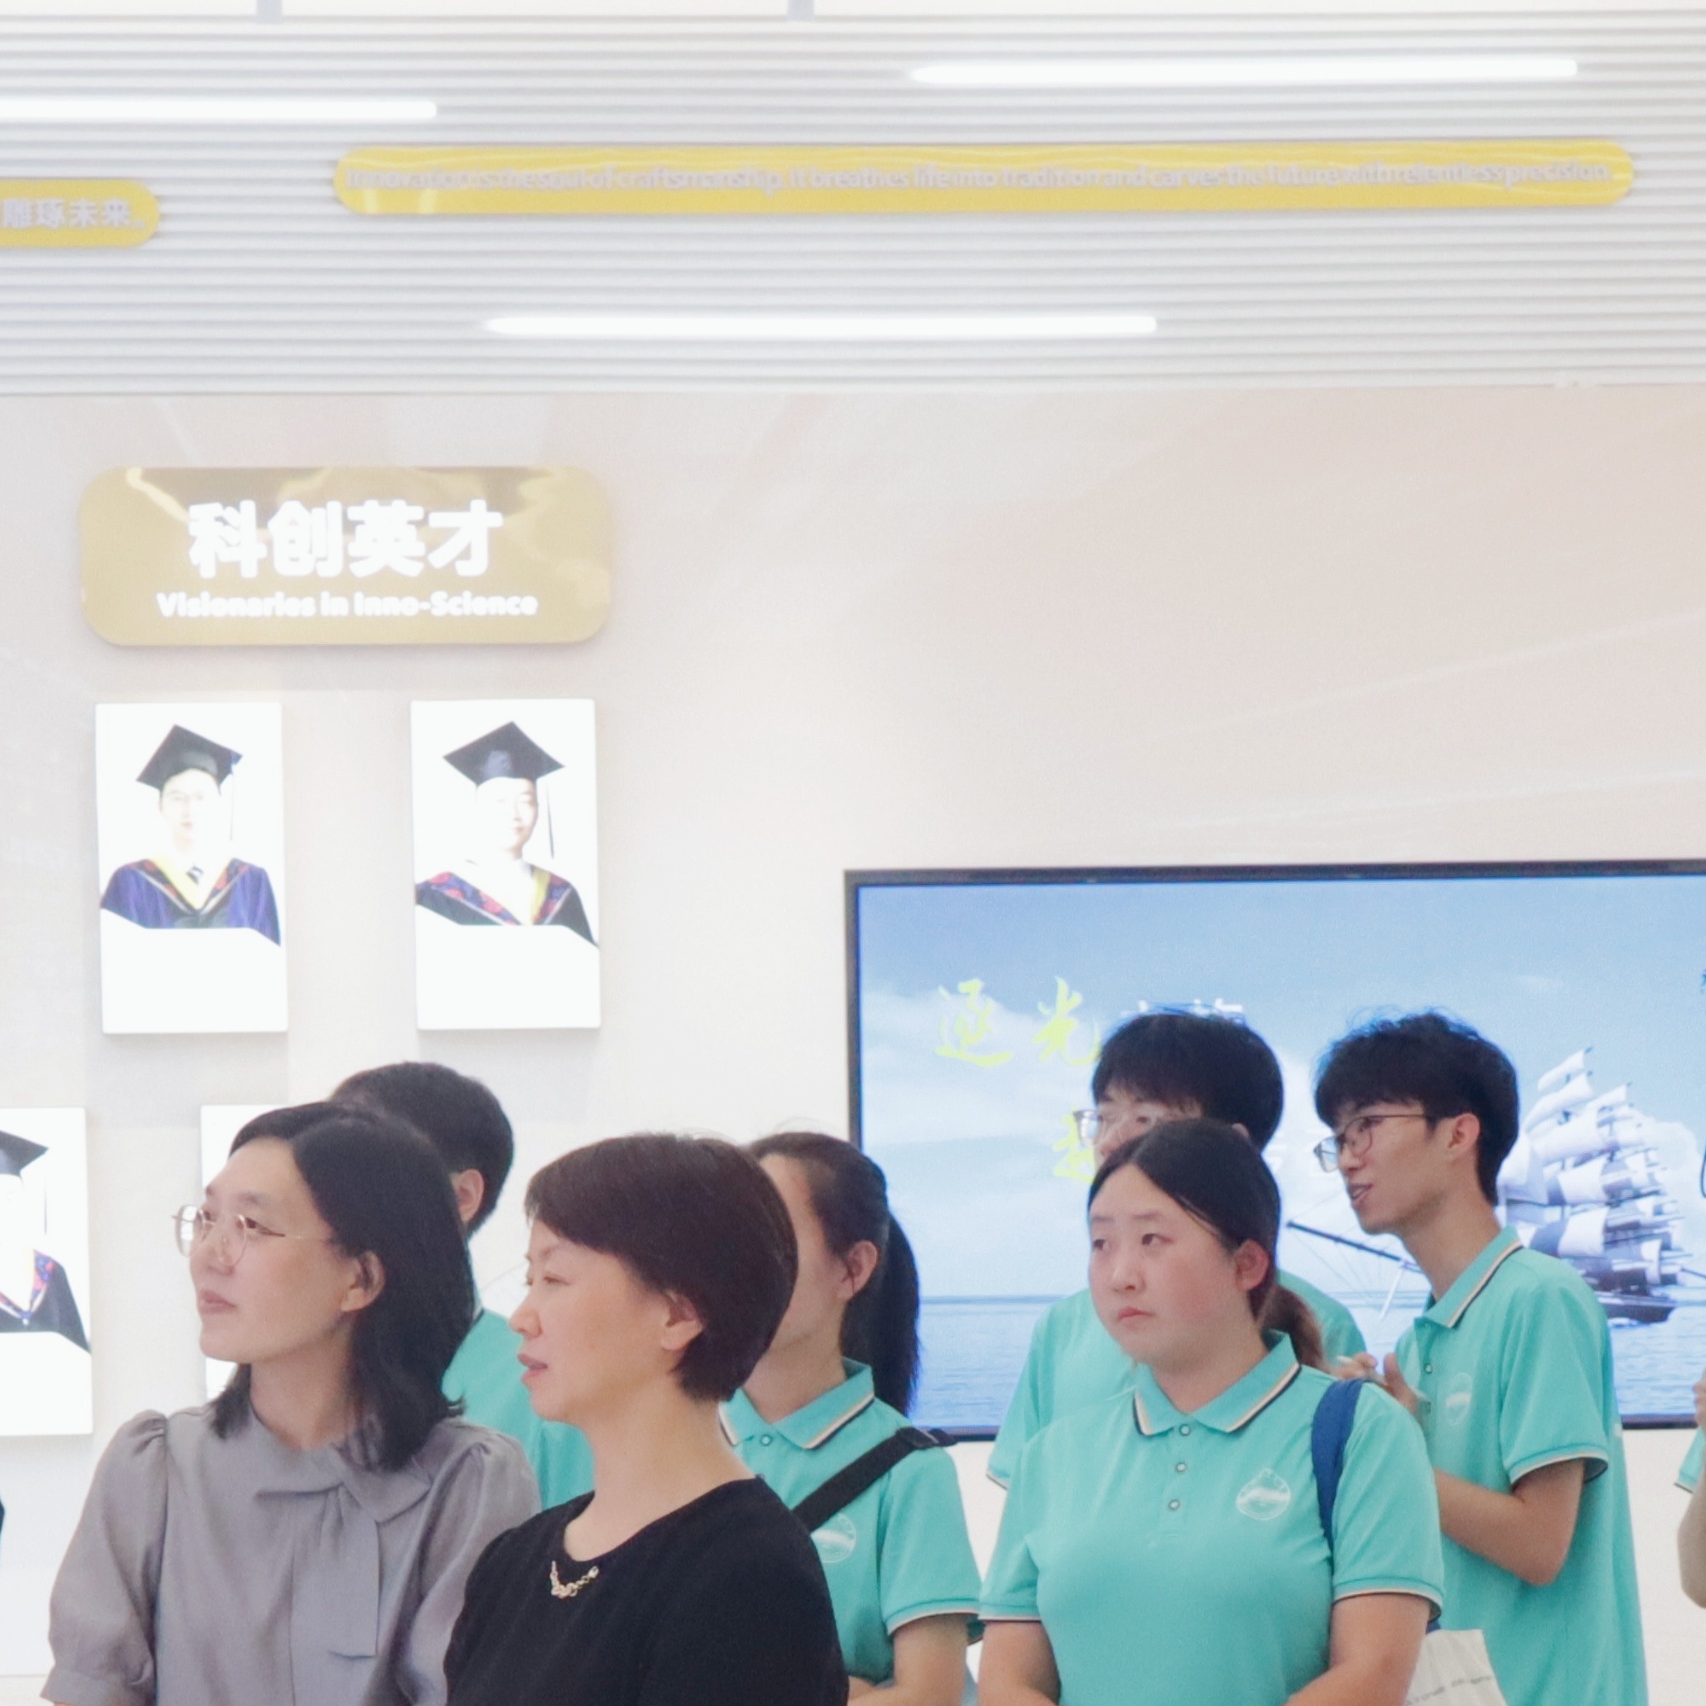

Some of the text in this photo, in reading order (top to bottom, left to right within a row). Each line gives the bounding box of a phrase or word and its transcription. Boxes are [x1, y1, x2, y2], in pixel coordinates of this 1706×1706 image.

[188, 499, 504, 580] 科创英才
[156, 591, 539, 619] Visionaries in Inno-Science
